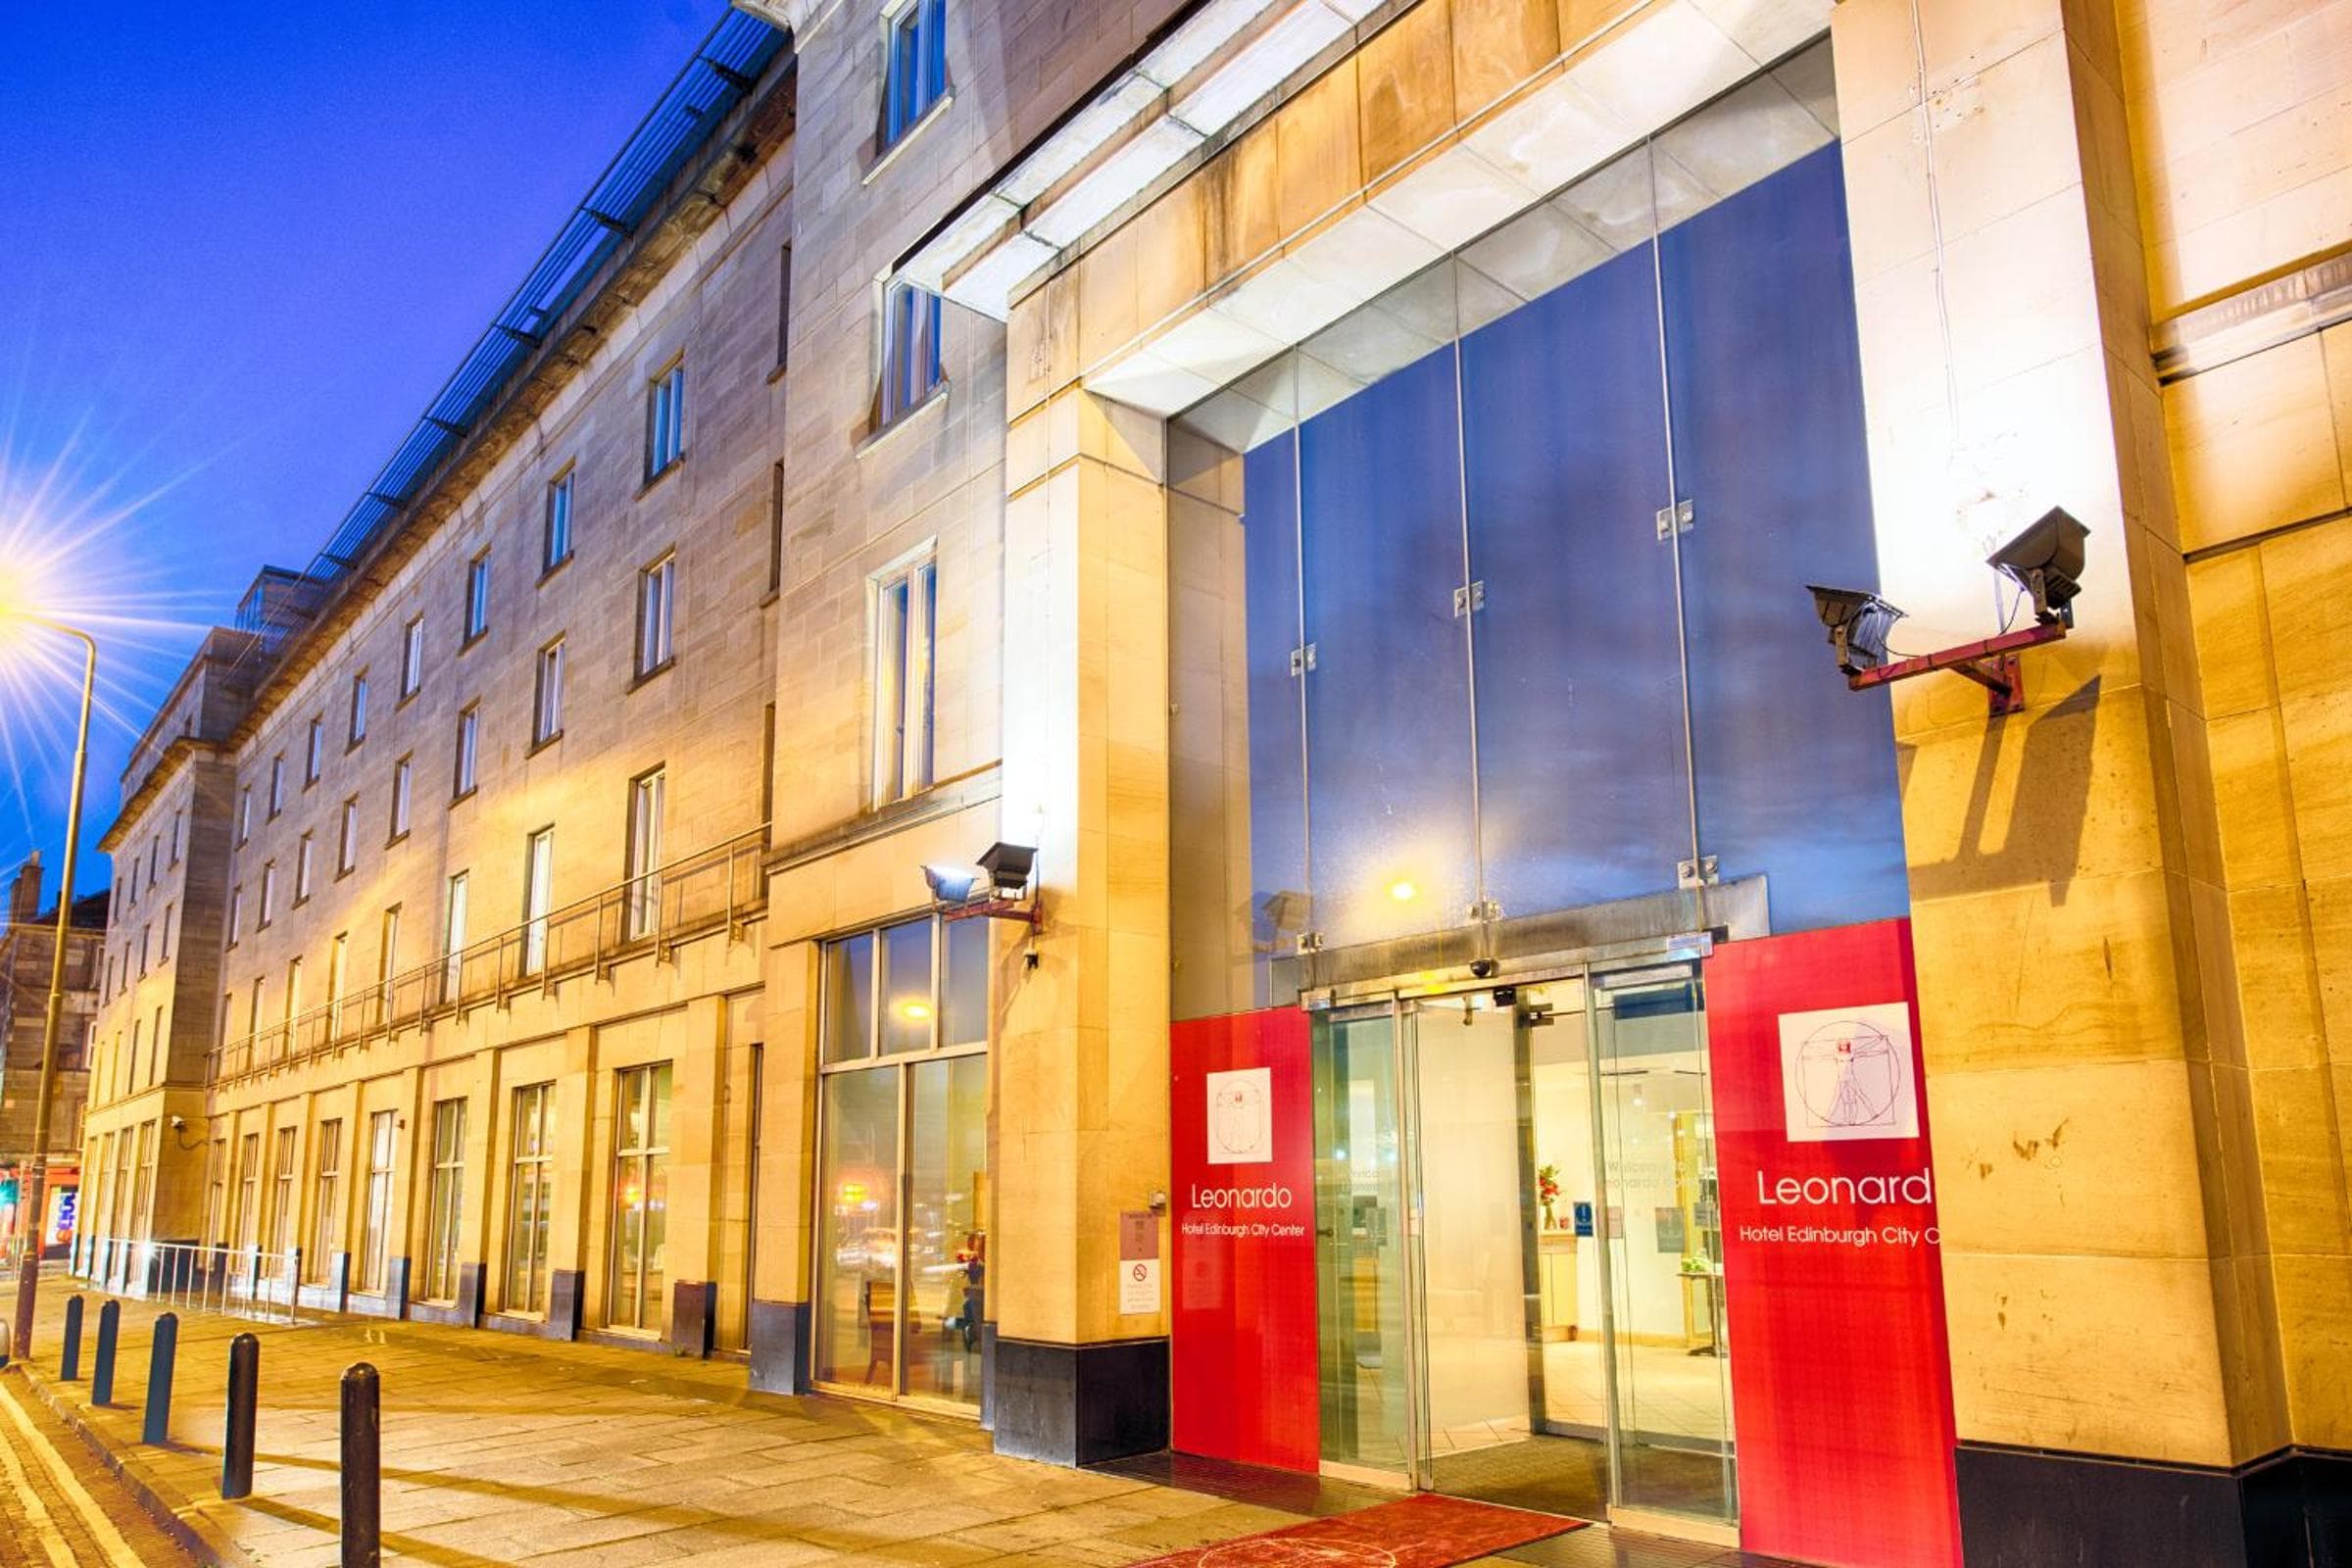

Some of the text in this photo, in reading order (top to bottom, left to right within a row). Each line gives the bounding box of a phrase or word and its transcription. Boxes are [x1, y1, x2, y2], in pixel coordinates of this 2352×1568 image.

[1192, 1182, 1293, 1208] Leonardo
[1757, 1167, 1933, 1204] Leonard
[1182, 1223, 1304, 1238] Hotel Edinburgh City Center
[1740, 1226, 1784, 1242] Hotel
[1788, 1226, 1878, 1247] Edinburgh
[1882, 1226, 1920, 1249] City
